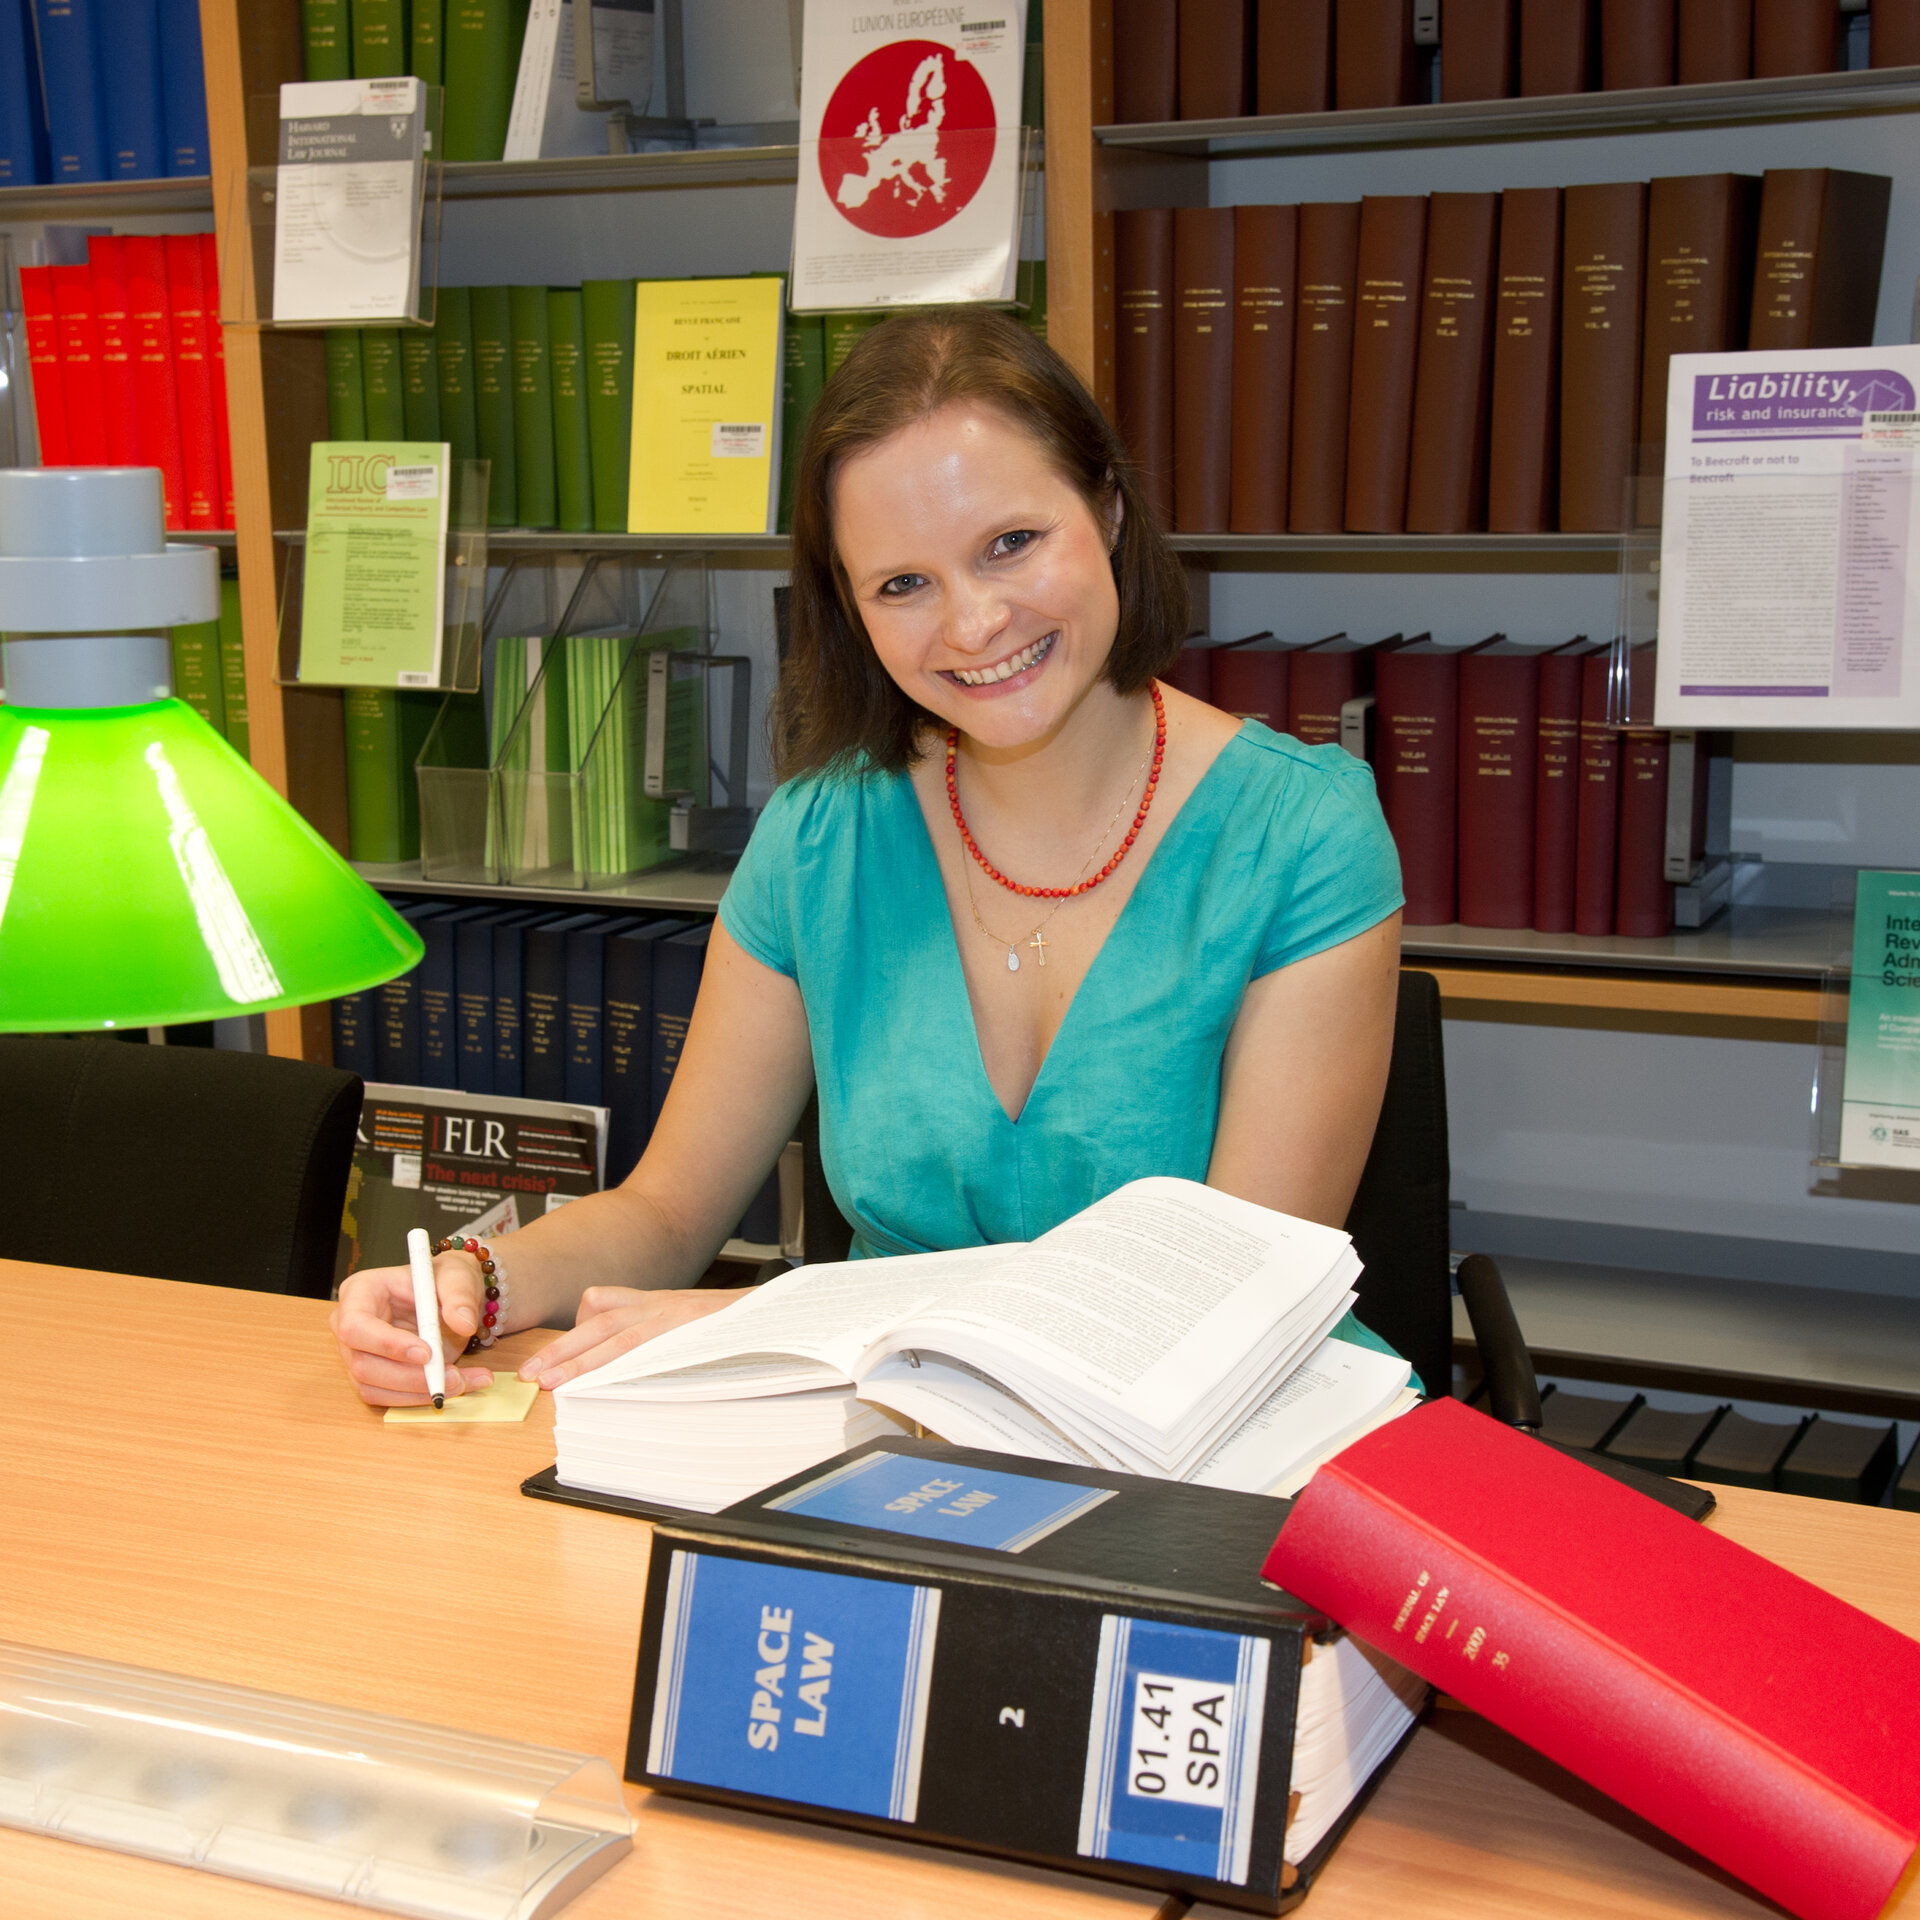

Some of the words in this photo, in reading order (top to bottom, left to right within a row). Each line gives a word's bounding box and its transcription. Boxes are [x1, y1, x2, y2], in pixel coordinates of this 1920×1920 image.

[852, 14, 894, 34] L'UNION
[666, 351, 701, 361] DROIT
[705, 348, 746, 360] AÉRIEN
[681, 384, 727, 394] SPATIAL
[1709, 372, 1858, 403] Liability,
[1706, 408, 1736, 422] risk
[1741, 407, 1771, 420] and
[1778, 406, 1856, 419] insurance
[326, 454, 396, 495] IIC
[1690, 457, 1702, 466] To
[1705, 456, 1749, 466] Beecroft
[1766, 456, 1784, 464] not
[1788, 456, 1800, 464] to
[1689, 474, 1734, 484] Beecroft
[1886, 914, 1920, 931] Inte
[432, 1115, 512, 1159] IFLR
[426, 1163, 456, 1182] The
[459, 1170, 497, 1187] next
[502, 1174, 556, 1192] crisis?
[884, 1478, 964, 1514] SPACE
[938, 1490, 999, 1518] LAW
[1431, 1586, 1450, 1612] LAW
[1462, 1626, 1486, 1661] 2009
[1492, 1650, 1510, 1671] 35
[747, 1604, 794, 1752] SPACE
[794, 1631, 834, 1738] LAW
[999, 1706, 1025, 1728] 2
[1134, 1683, 1174, 1794] 01.41
[1186, 1694, 1225, 1789] SPA
